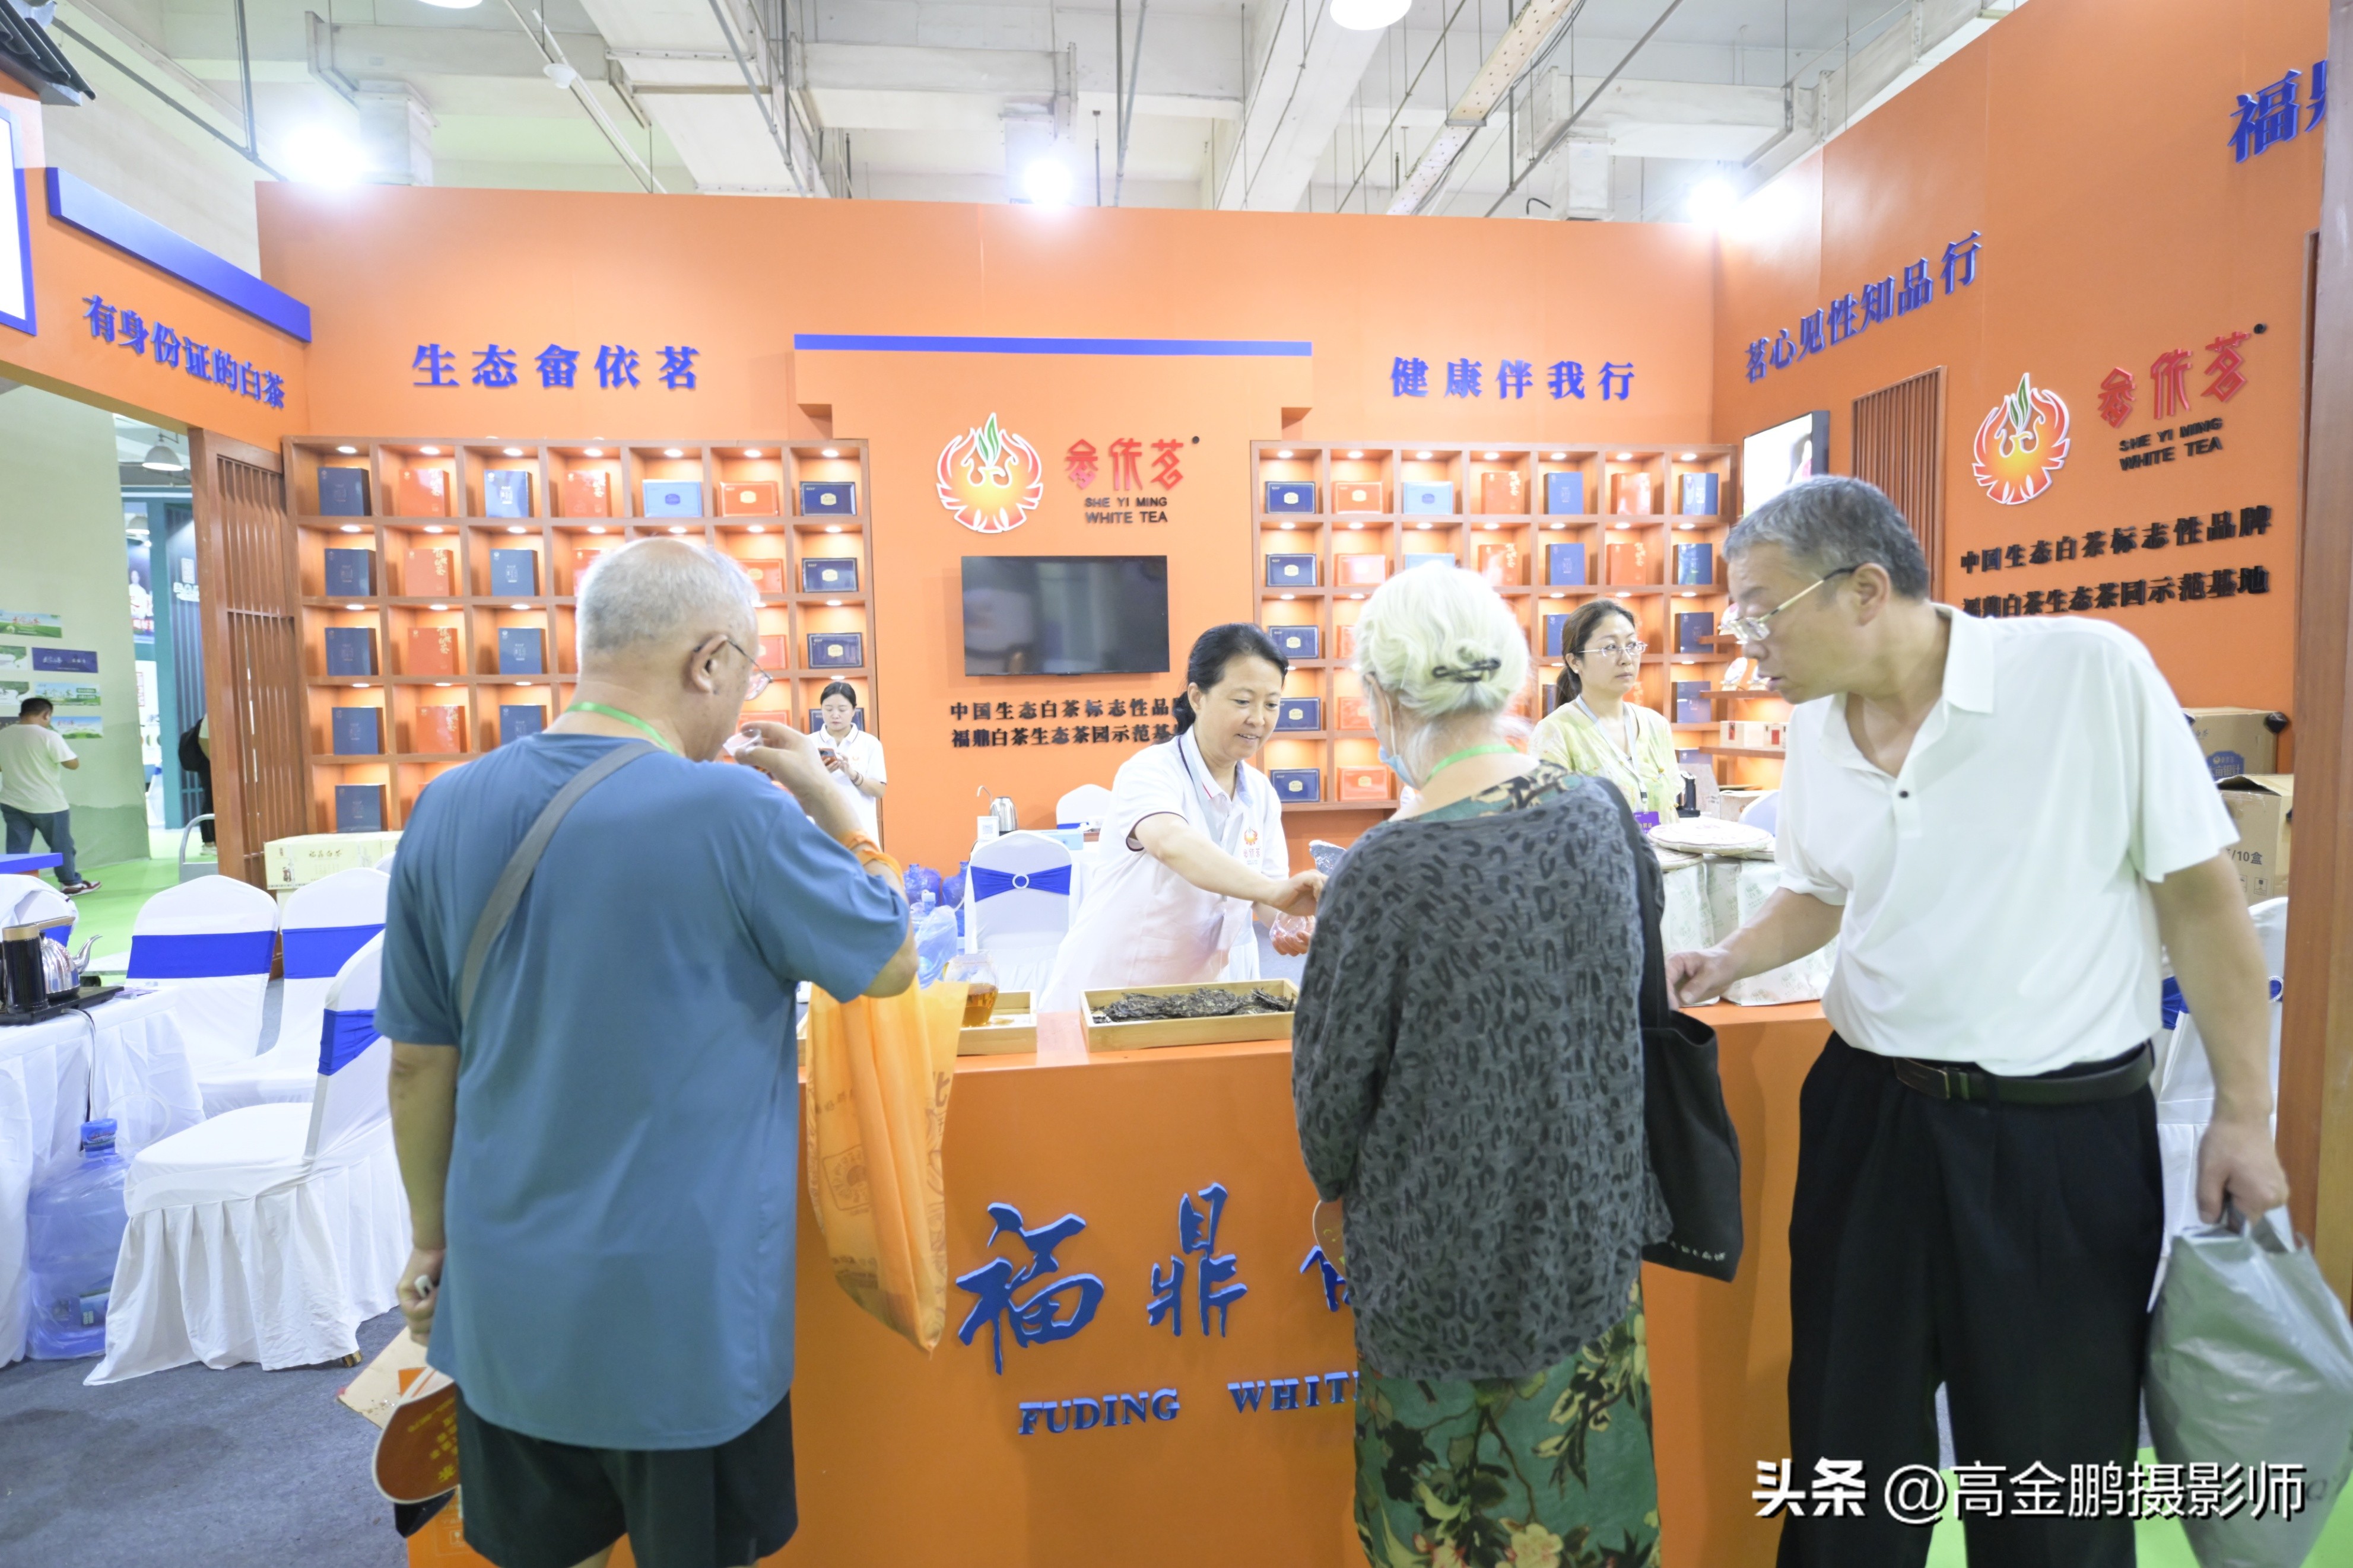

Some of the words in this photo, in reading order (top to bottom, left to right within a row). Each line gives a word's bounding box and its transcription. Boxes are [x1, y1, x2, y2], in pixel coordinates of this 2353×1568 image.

[1745, 230, 1982, 383] 茗心见性知品行
[82, 294, 286, 409] 有身份证的白茶
[412, 343, 700, 389] 生态畲依茗
[1390, 356, 1635, 401] 健康伴我行
[2119, 434, 2151, 451] SHE
[2157, 428, 2173, 443] YI
[2180, 418, 2223, 438] MING
[2119, 446, 2176, 471] WHITE
[2184, 436, 2223, 457] TEA
[1085, 497, 1110, 507] SHE
[1117, 497, 1129, 507] YI
[1136, 497, 1167, 507] MING
[1085, 511, 1133, 523] WHITE
[1139, 511, 1168, 523] TEA
[1960, 504, 2272, 574] 中国生态白茶标志性品牌
[951, 697, 1179, 720] 中国生态白茶标志性品
[951, 723, 1177, 748] 福鼎白茶生态茶园示范基
[1018, 1388, 1180, 1435] FUDING
